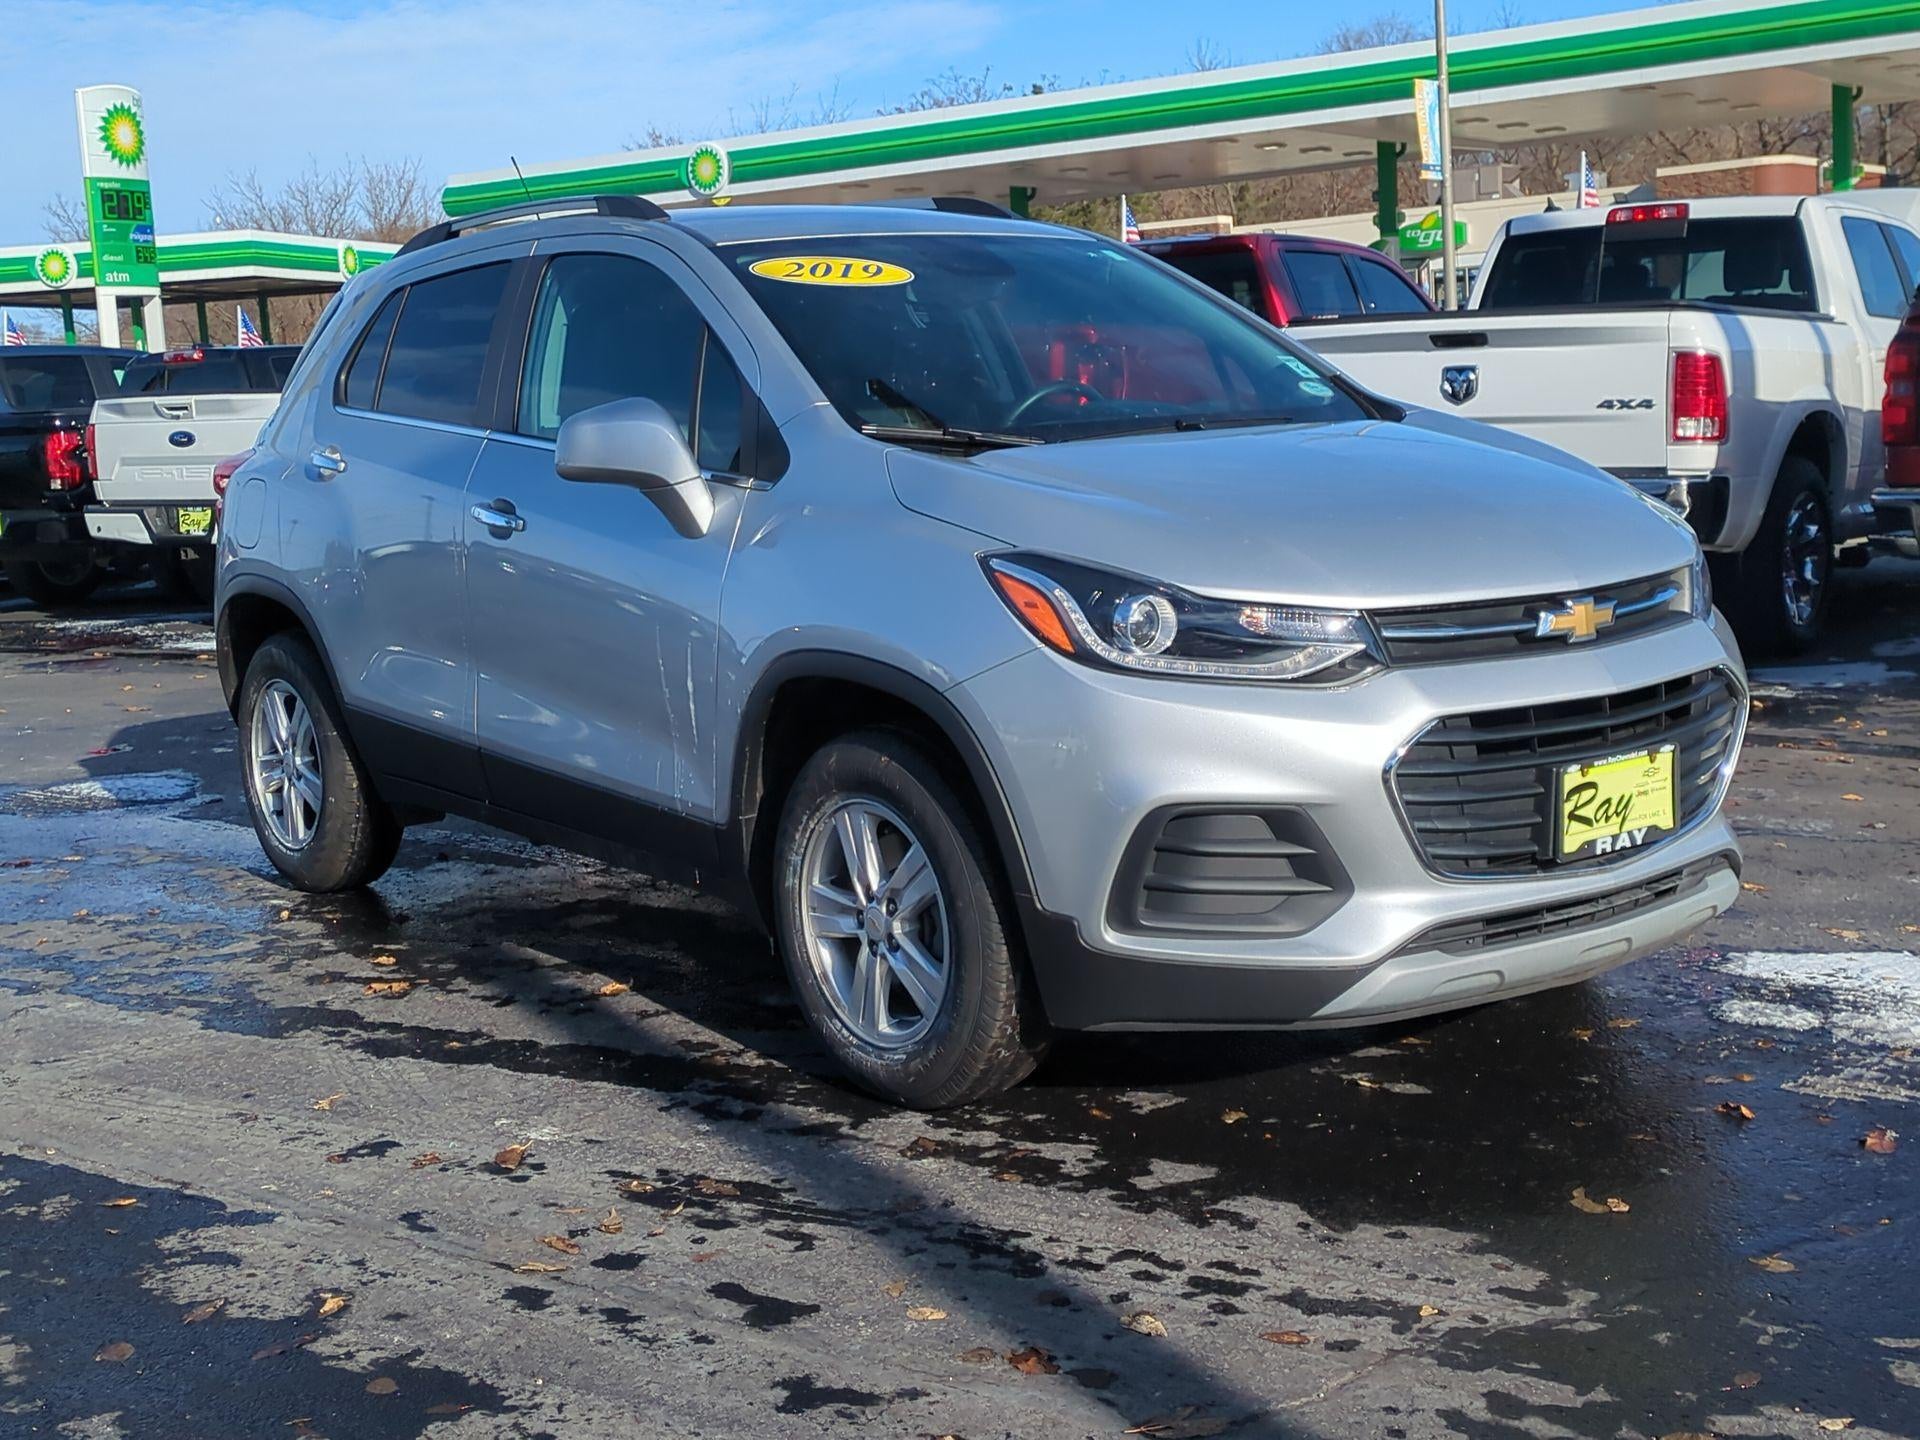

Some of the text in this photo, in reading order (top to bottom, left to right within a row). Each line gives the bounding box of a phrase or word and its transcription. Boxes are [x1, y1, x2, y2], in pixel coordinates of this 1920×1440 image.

[1406, 229, 1421, 238] to
[104, 270, 130, 282] atm
[782, 262, 883, 279] 2019
[180, 513, 201, 529] Ray
[1564, 781, 1634, 836] Ray
[1595, 826, 1648, 856] RAY
